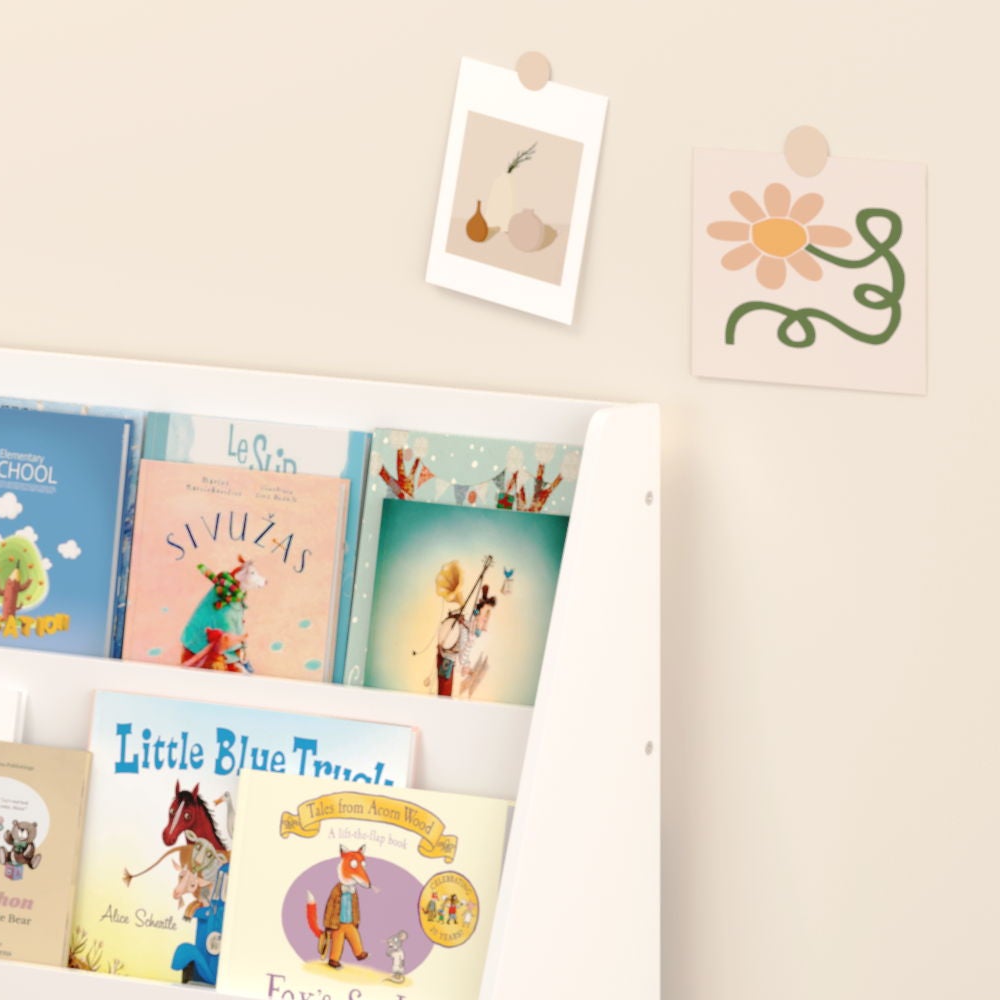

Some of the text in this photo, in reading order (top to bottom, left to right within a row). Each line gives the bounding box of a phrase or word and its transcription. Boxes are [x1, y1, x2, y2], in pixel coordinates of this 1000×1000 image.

[227, 422, 249, 465] Le
[166, 510, 313, 574] SIVUŽAS
[114, 722, 204, 774] Little
[214, 727, 286, 776] Blue
[306, 798, 435, 835] Tales from Acorn Wood
[388, 834, 408, 849] book
[8, 913, 32, 926] Bear
[99, 903, 130, 924] Alice
